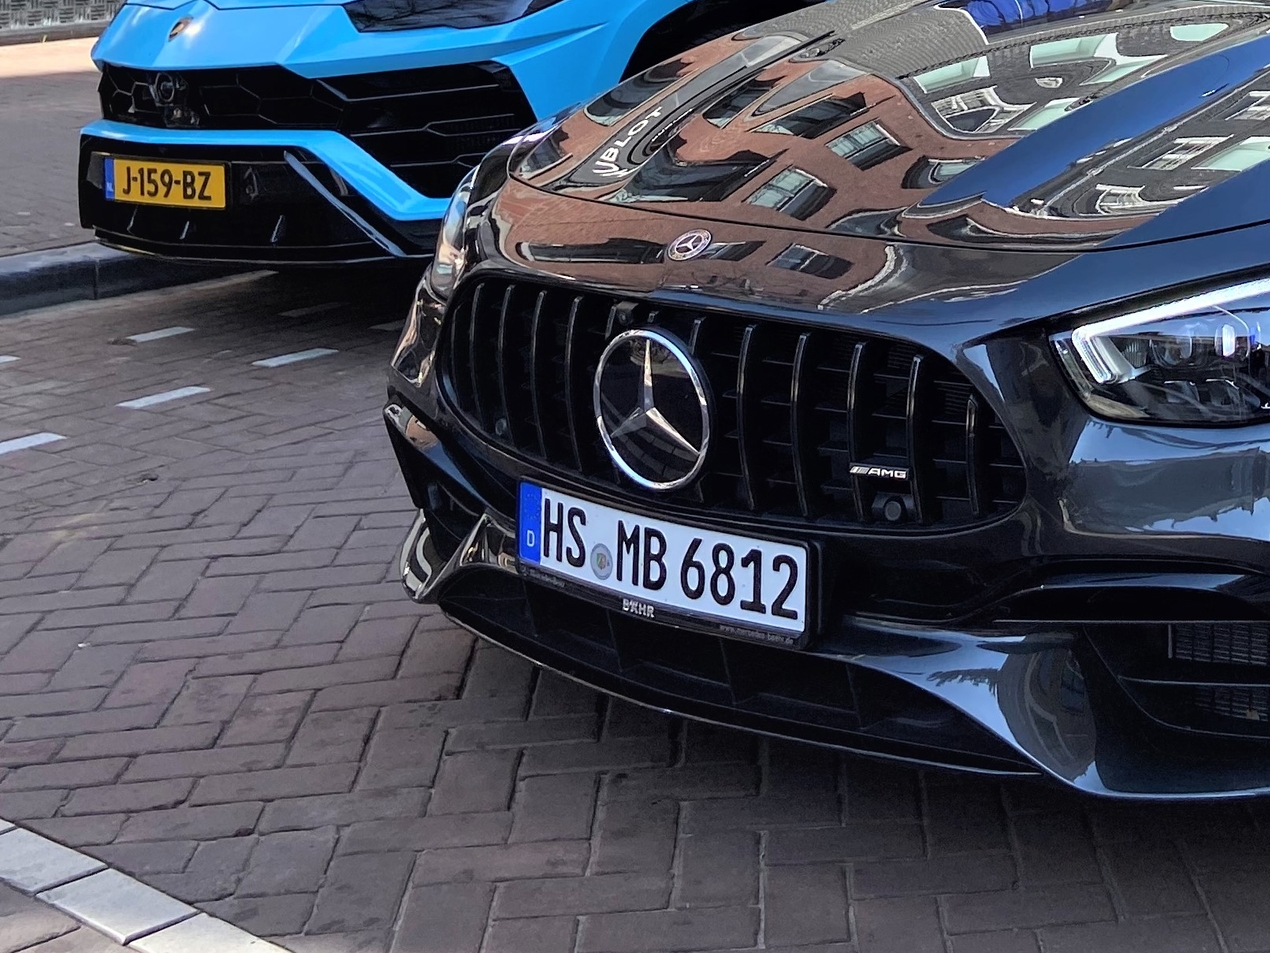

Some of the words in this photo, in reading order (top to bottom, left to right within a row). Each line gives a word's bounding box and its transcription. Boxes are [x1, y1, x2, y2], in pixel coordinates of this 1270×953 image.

[122, 165, 212, 201] J-159-BZ
[526, 529, 535, 548] D
[543, 497, 588, 568] HS
[616, 519, 668, 591] MB
[680, 537, 799, 621] 6812
